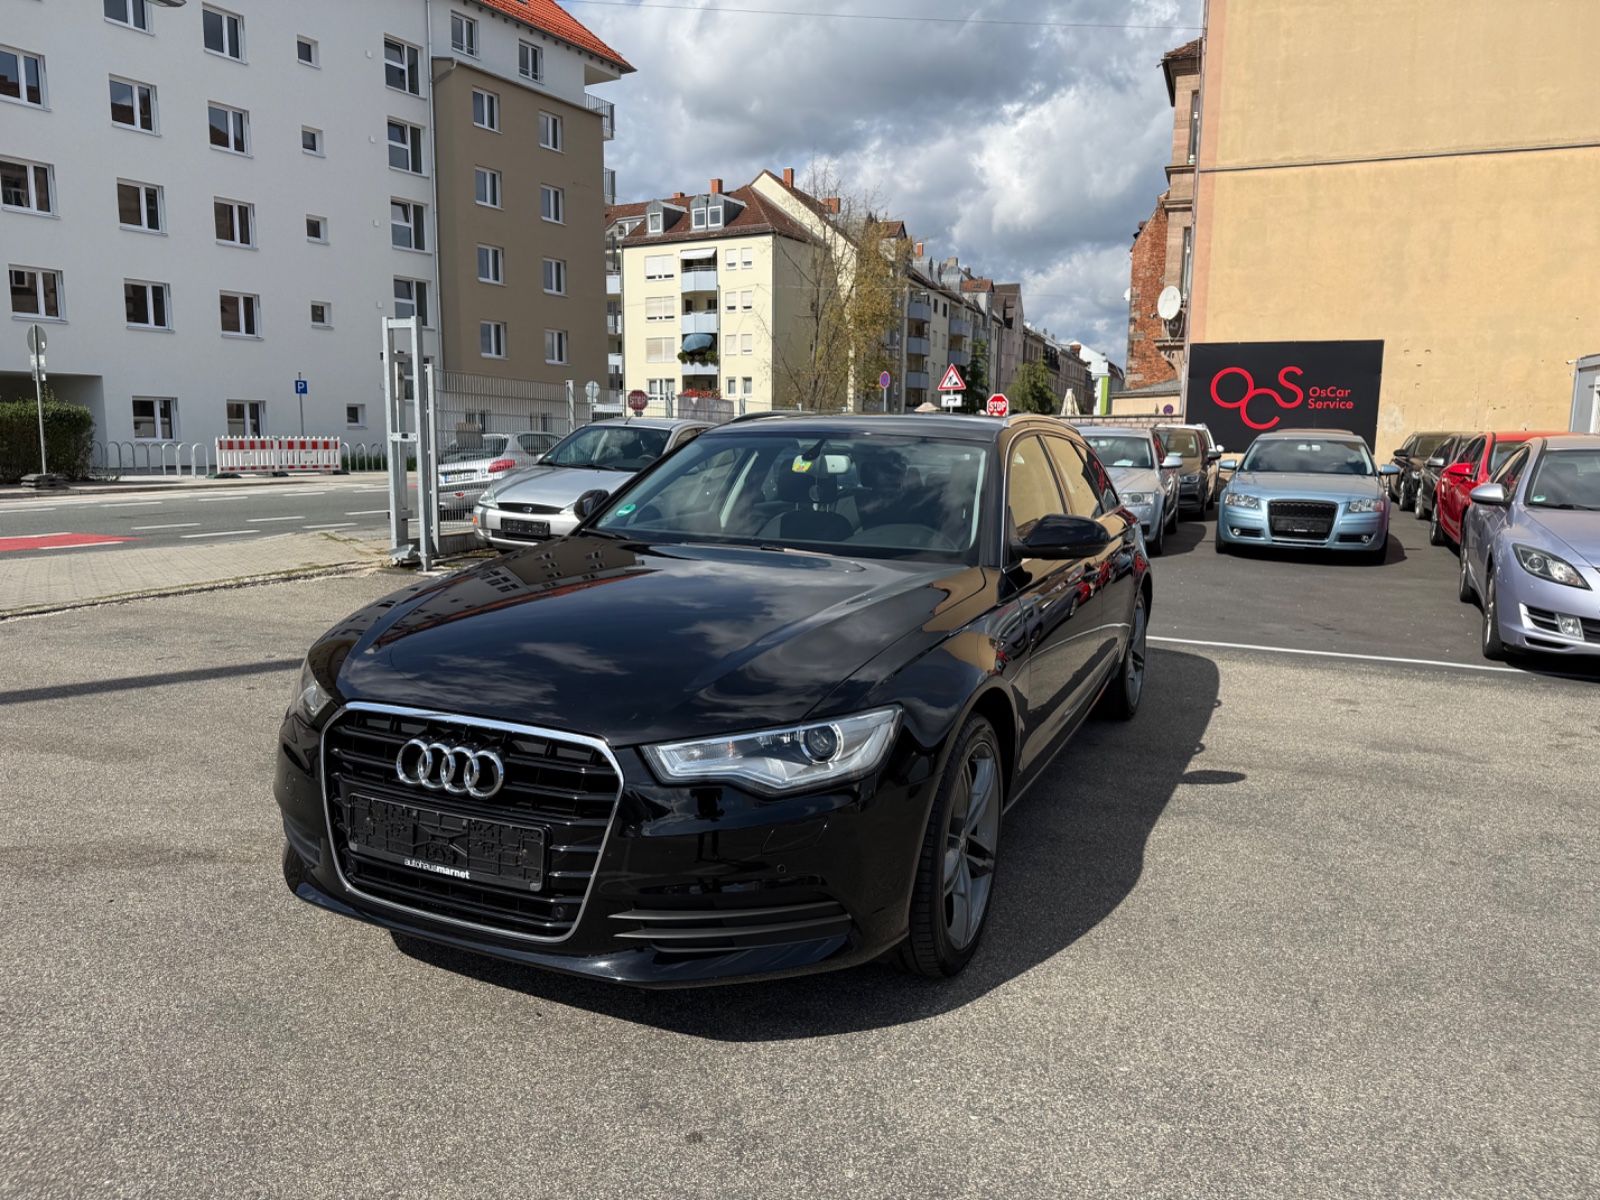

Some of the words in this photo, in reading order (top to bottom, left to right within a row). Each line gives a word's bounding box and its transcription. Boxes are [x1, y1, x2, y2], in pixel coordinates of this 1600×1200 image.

[1309, 386, 1351, 397] OsCar
[988, 401, 1007, 411] STOP
[1308, 399, 1354, 409] Service
